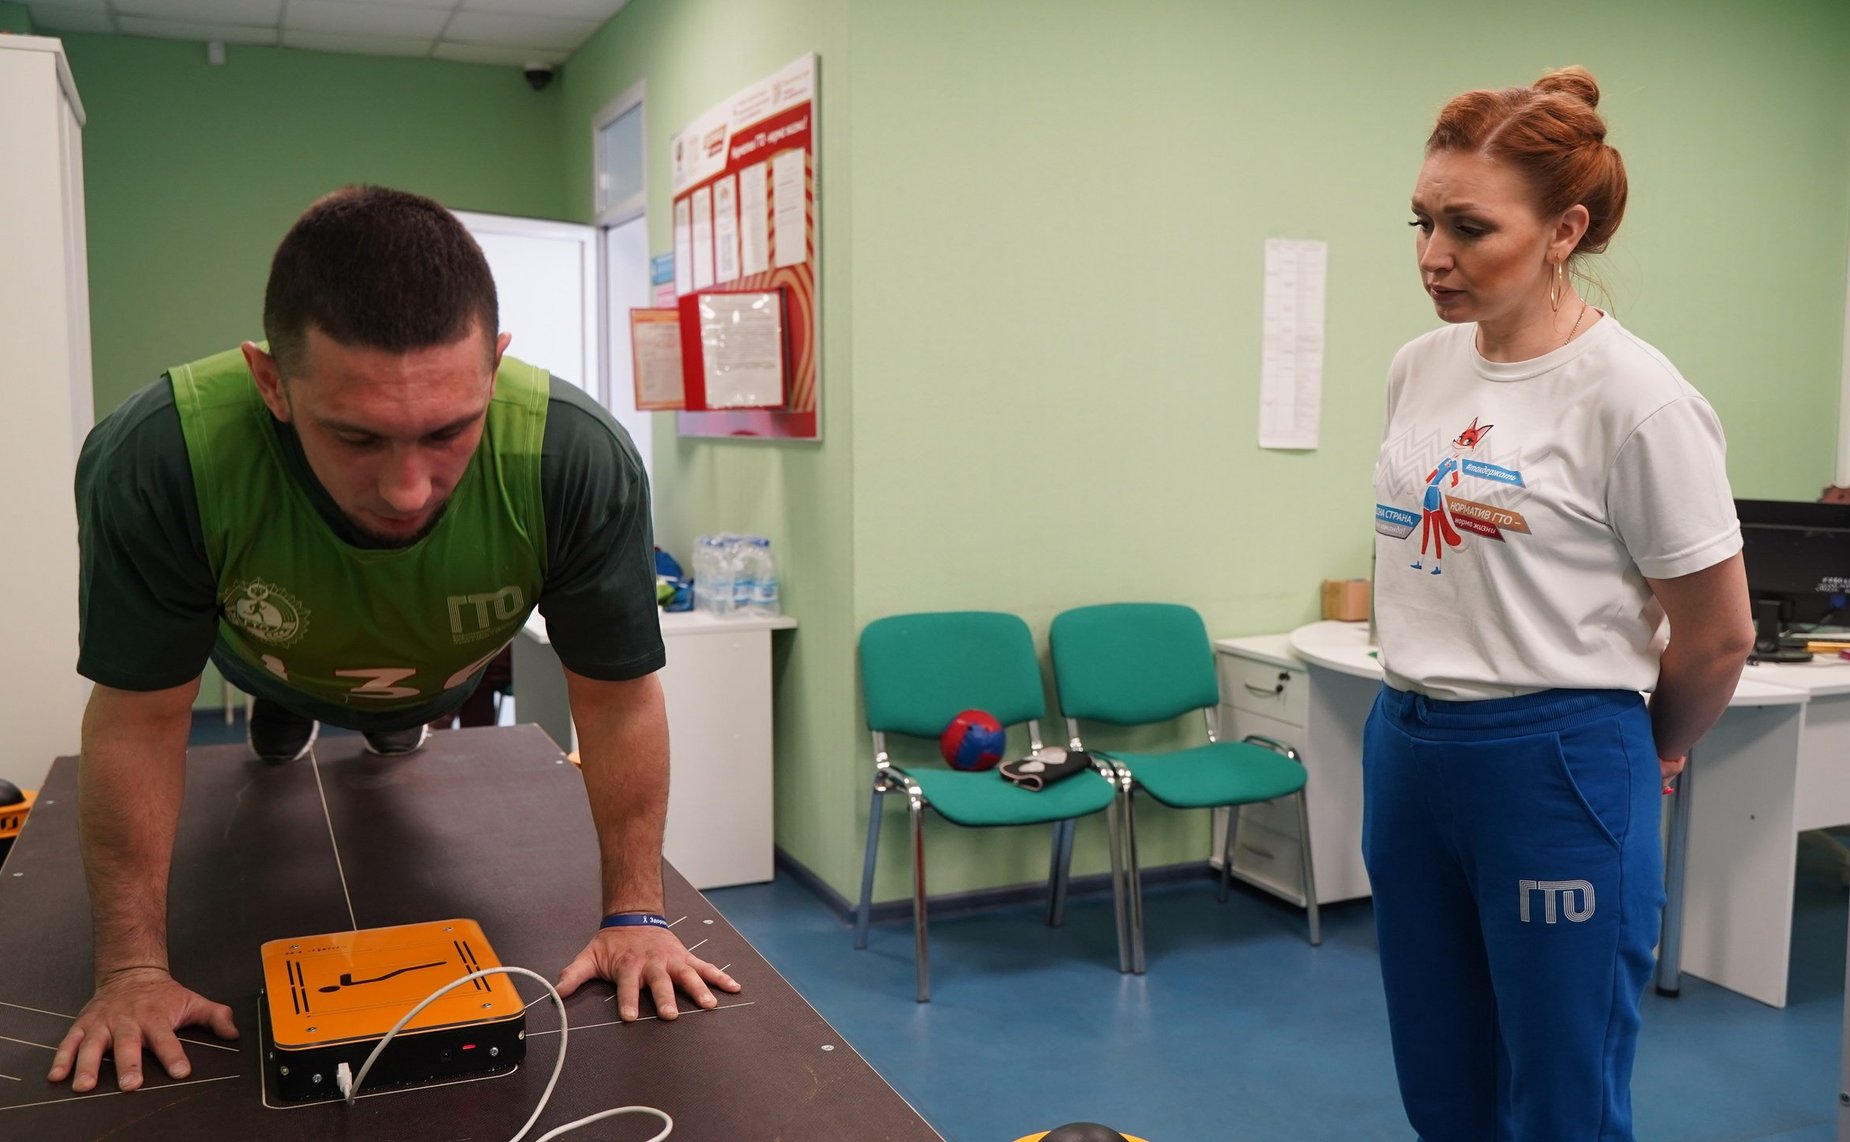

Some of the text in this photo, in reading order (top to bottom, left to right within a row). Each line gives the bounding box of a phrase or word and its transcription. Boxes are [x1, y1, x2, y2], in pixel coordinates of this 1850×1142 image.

[1384, 510, 1413, 525] СТРАНА,
[1450, 501, 1491, 520] НОРМАТИВ
[1492, 512, 1513, 525] ГТО
[1454, 518, 1496, 534] норма жизни
[447, 585, 525, 633] ГТО
[1519, 879, 1596, 924] ГТО
